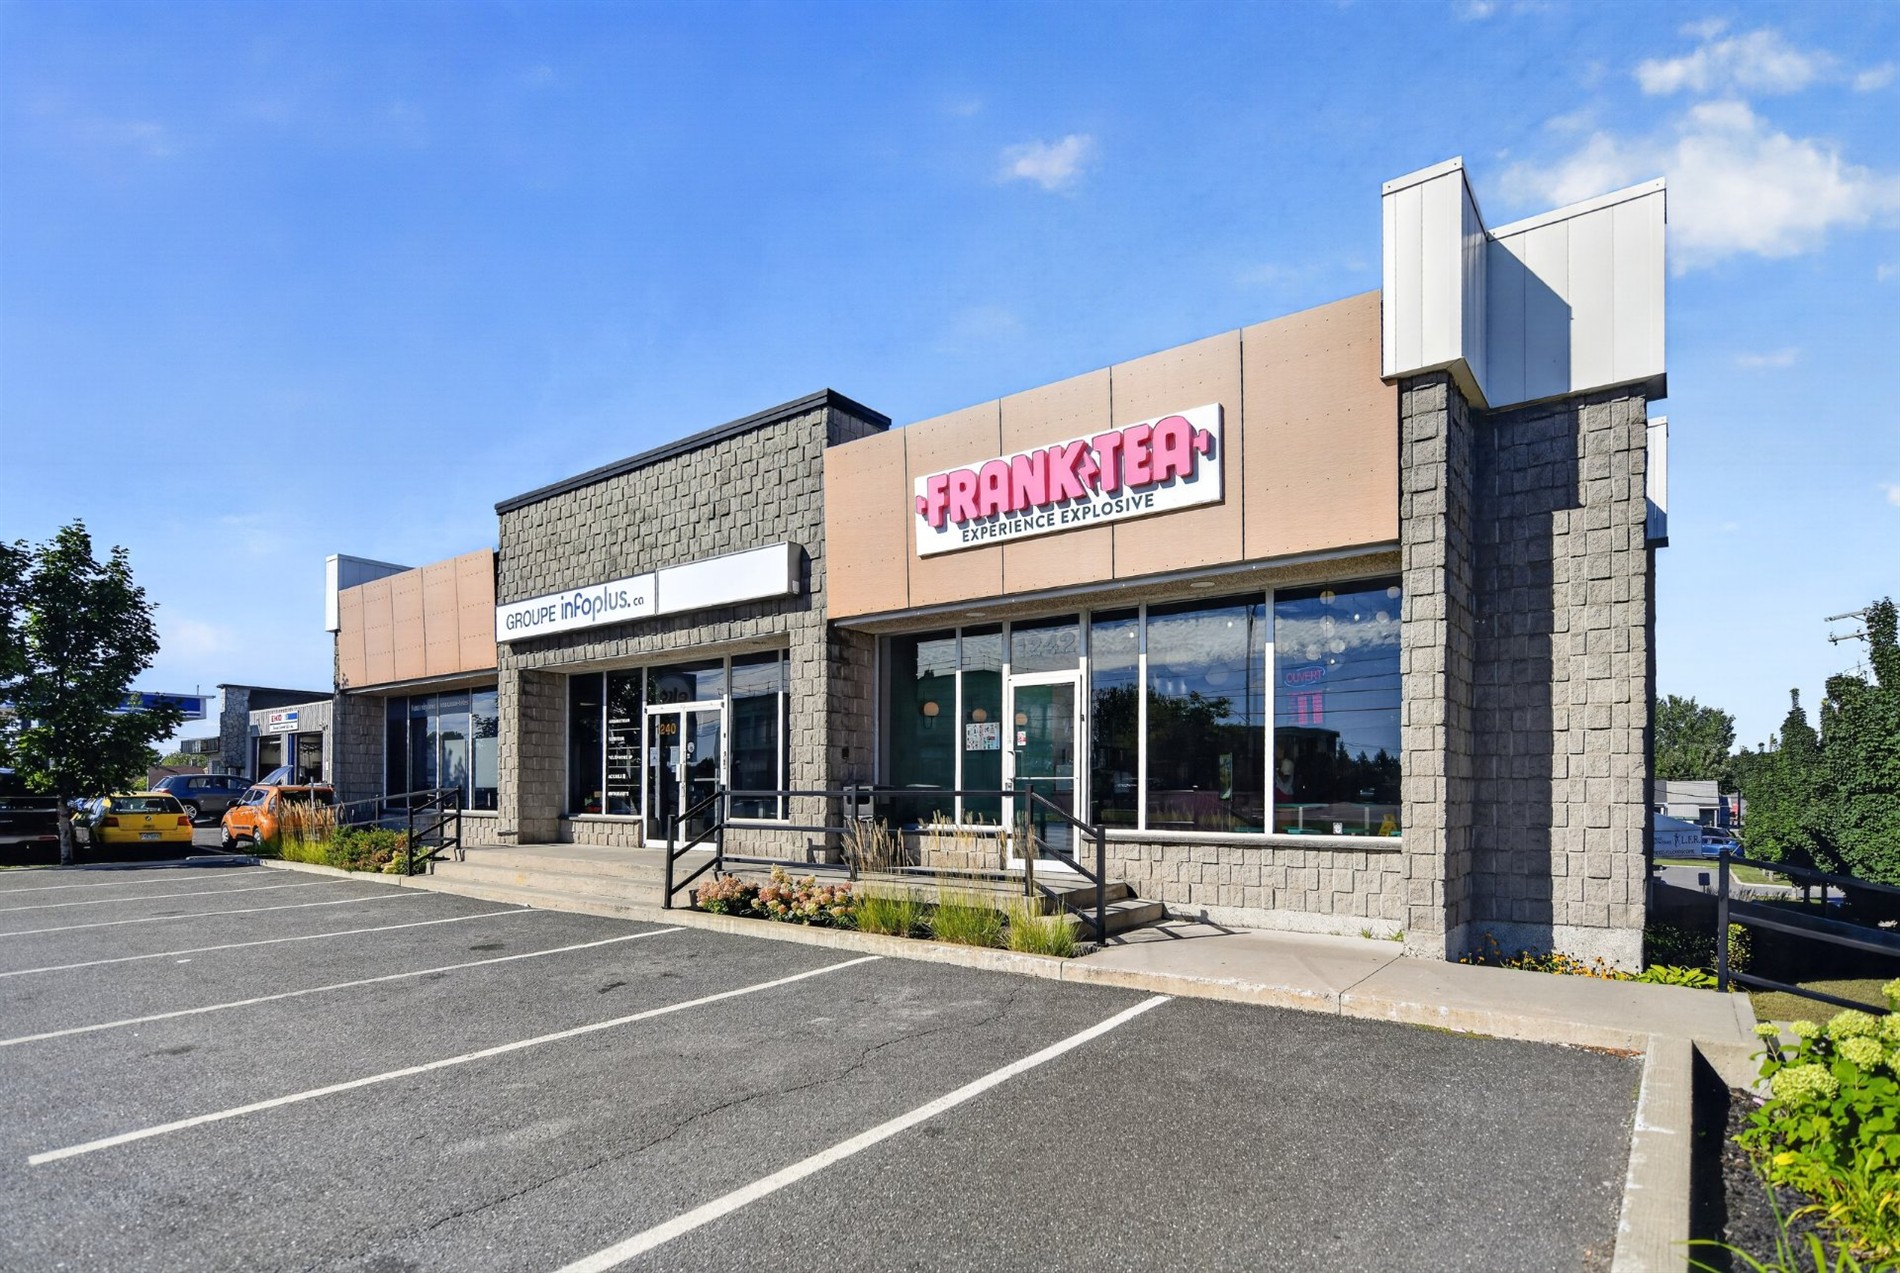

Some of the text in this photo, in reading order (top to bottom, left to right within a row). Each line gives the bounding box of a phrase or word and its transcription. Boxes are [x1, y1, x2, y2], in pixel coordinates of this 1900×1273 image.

[927, 415, 1197, 529] FRANK TEA
[1061, 493, 1154, 524] EXPLOSIVE
[506, 604, 557, 631] GROUPE
[1015, 632, 1076, 659] 1242
[1286, 669, 1323, 683] OUVERT
